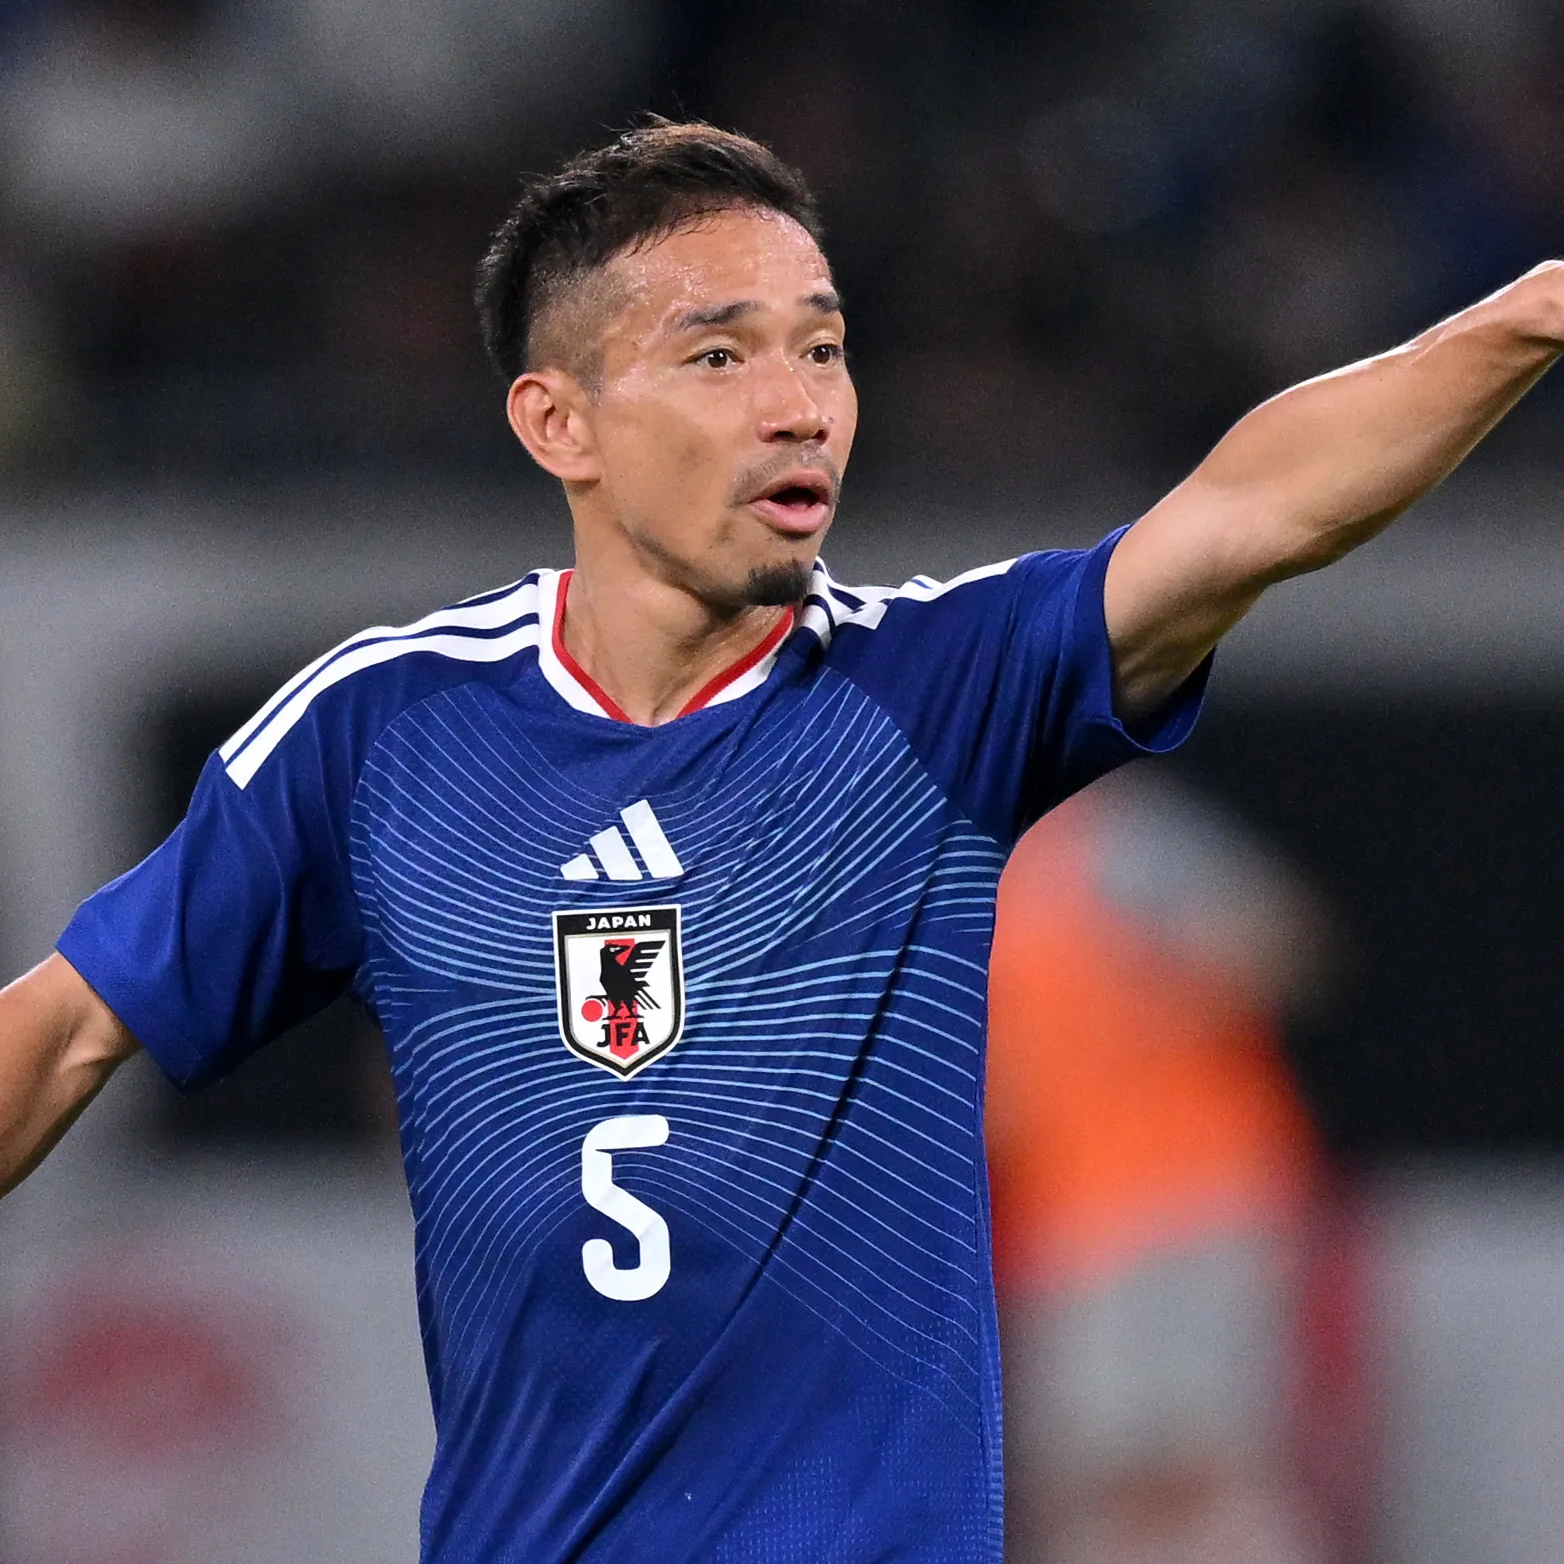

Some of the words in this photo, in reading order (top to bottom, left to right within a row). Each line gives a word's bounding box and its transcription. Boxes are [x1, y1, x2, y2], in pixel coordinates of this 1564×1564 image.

[586, 914, 651, 930] JAPAN
[596, 1022, 650, 1048] JFA
[582, 1114, 671, 1301] 5
